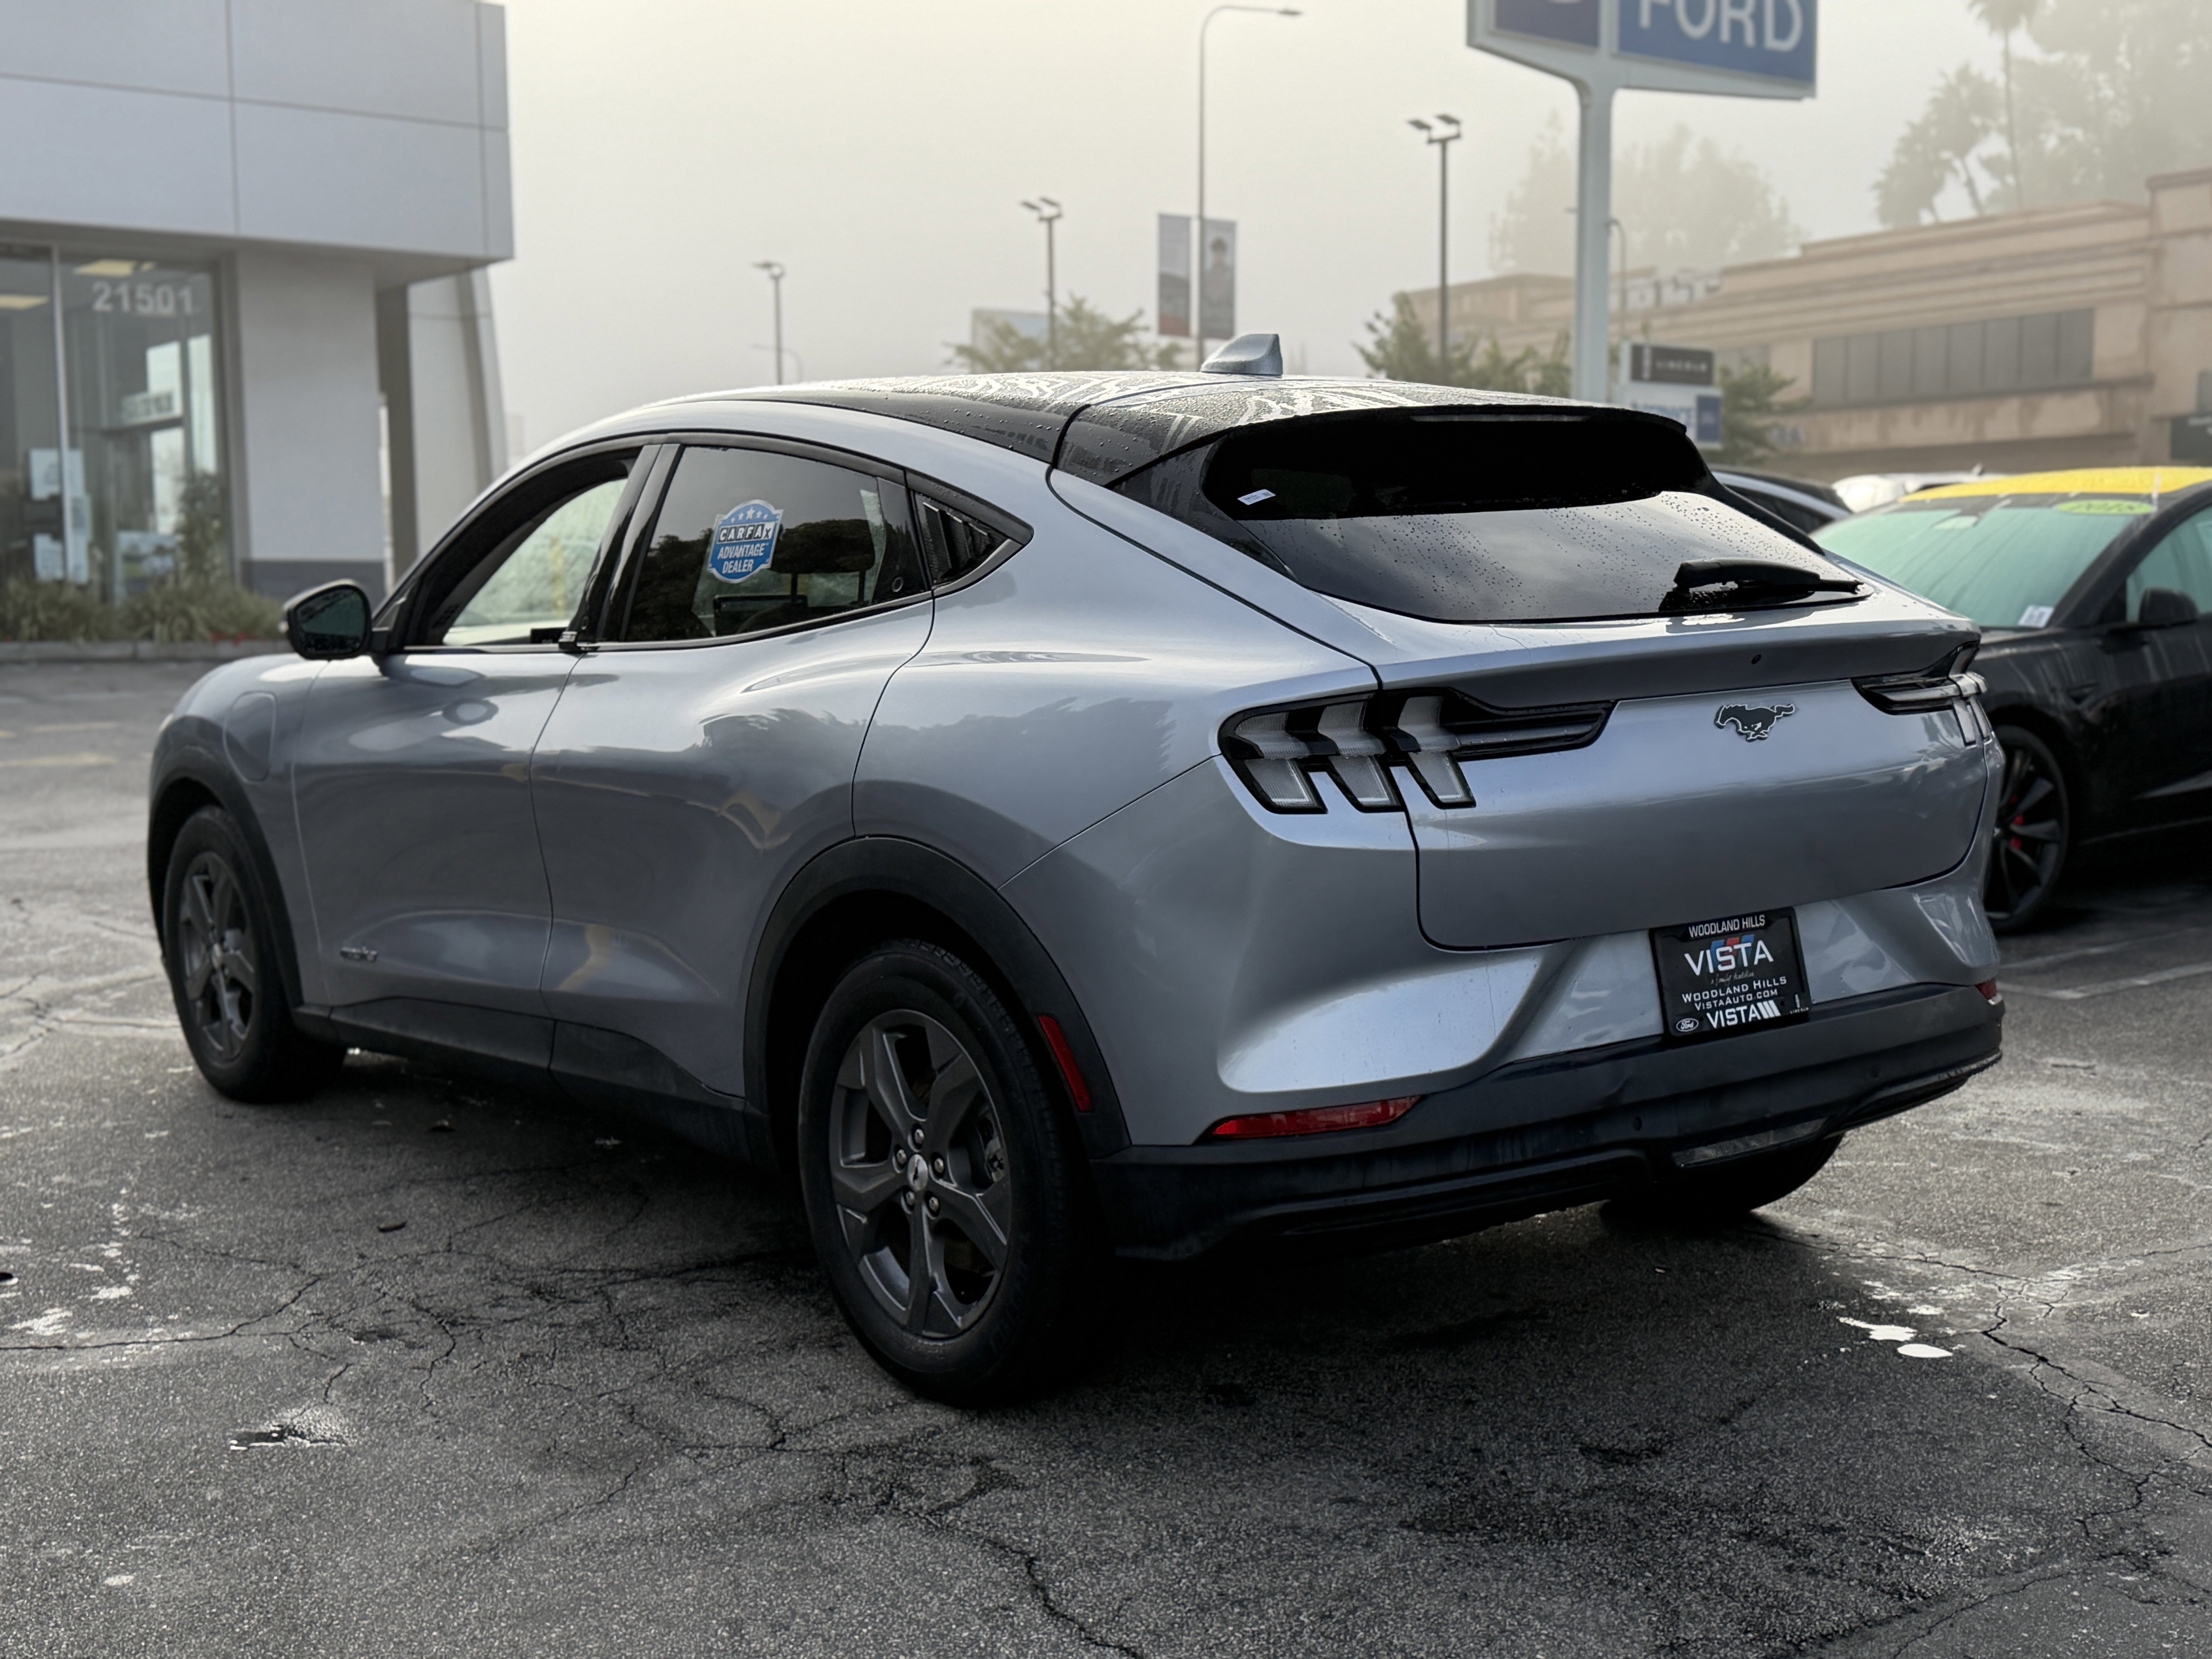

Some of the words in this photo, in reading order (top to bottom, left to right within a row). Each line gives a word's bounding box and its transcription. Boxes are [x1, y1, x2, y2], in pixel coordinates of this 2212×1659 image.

[92, 281, 193, 315] 21501
[719, 525, 772, 541] CARFAX
[717, 543, 765, 560] ADVANTAGE
[722, 559, 754, 574] DEALER
[1688, 918, 1740, 938] WOODLAND
[1742, 914, 1765, 930] HILLS
[1684, 940, 1774, 976] VISTA
[1682, 984, 1748, 1003] WOODLAND
[1753, 976, 1787, 990] HILLS
[1706, 1004, 1761, 1029] VISTA
